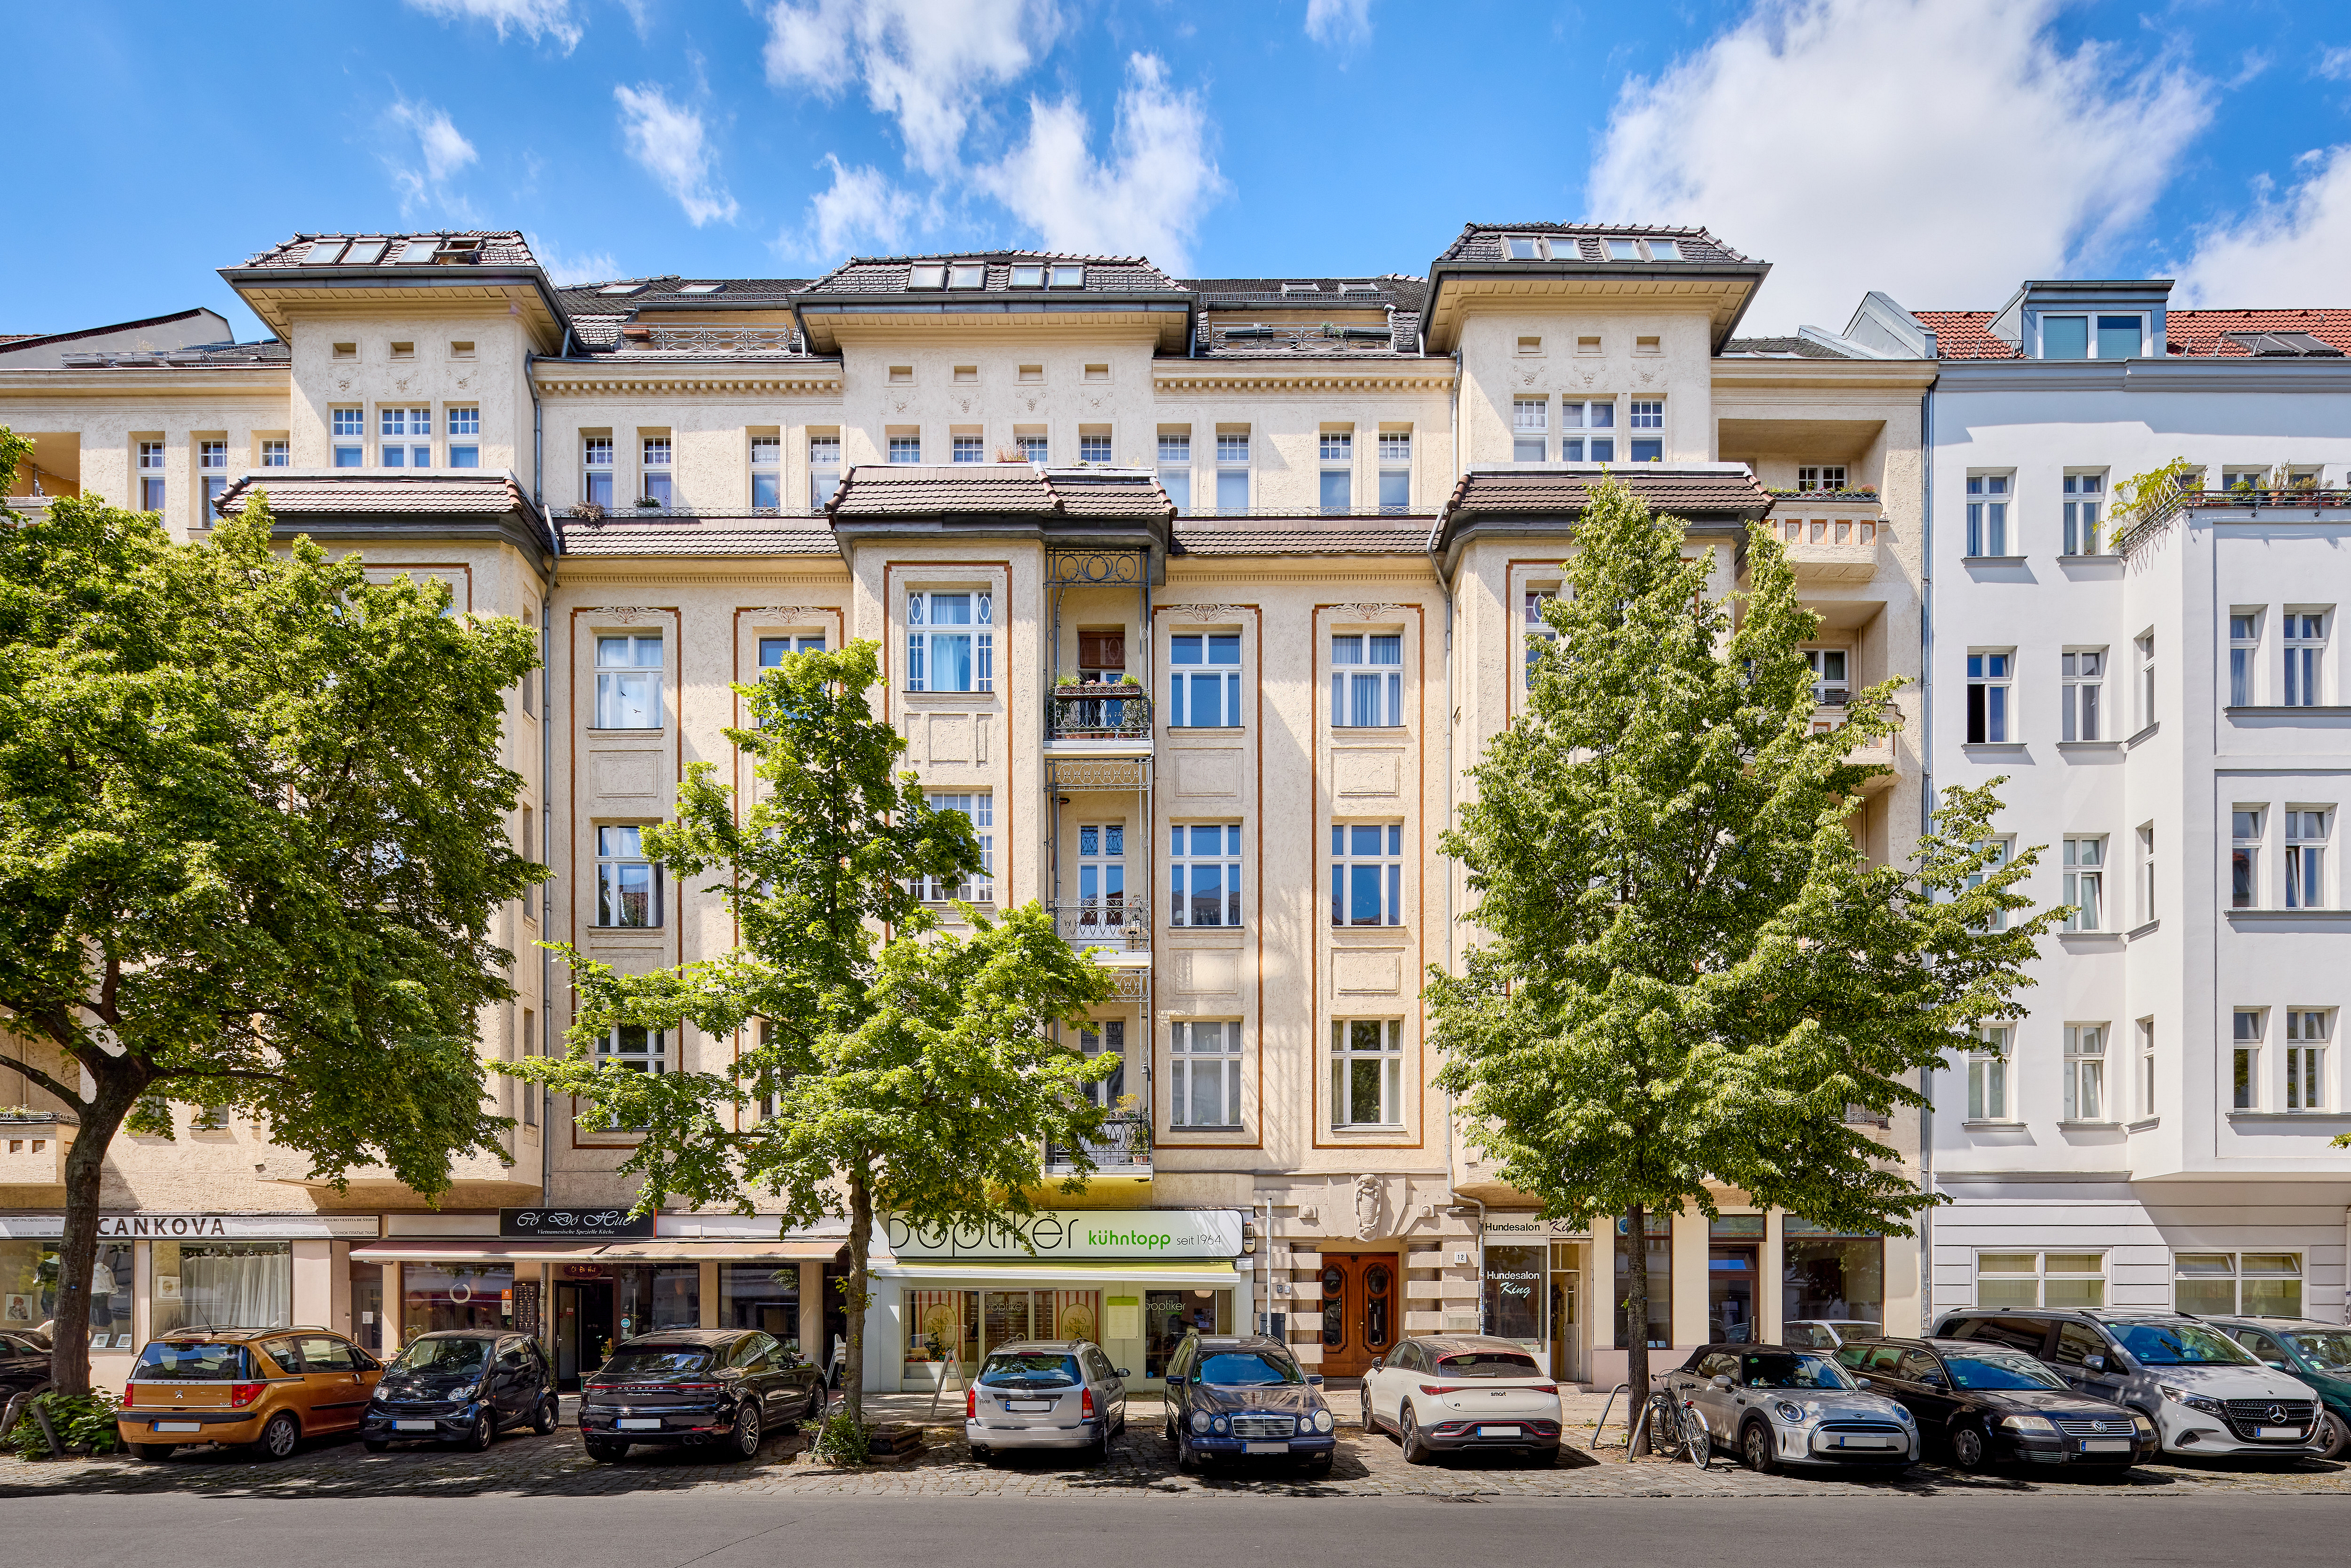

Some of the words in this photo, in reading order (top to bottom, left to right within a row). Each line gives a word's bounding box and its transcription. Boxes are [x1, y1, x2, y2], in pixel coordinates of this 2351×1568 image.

[98, 1218, 226, 1235] CANKOVA
[1485, 1222, 1541, 1232] Hundesalon
[1088, 1230, 1171, 1250] kühntopp
[1177, 1235, 1194, 1245] seit
[1197, 1234, 1221, 1245] 1964
[1487, 1271, 1540, 1279] Hundesalon
[1500, 1282, 1531, 1298] King
[1068, 1317, 1087, 1325] CIAO
